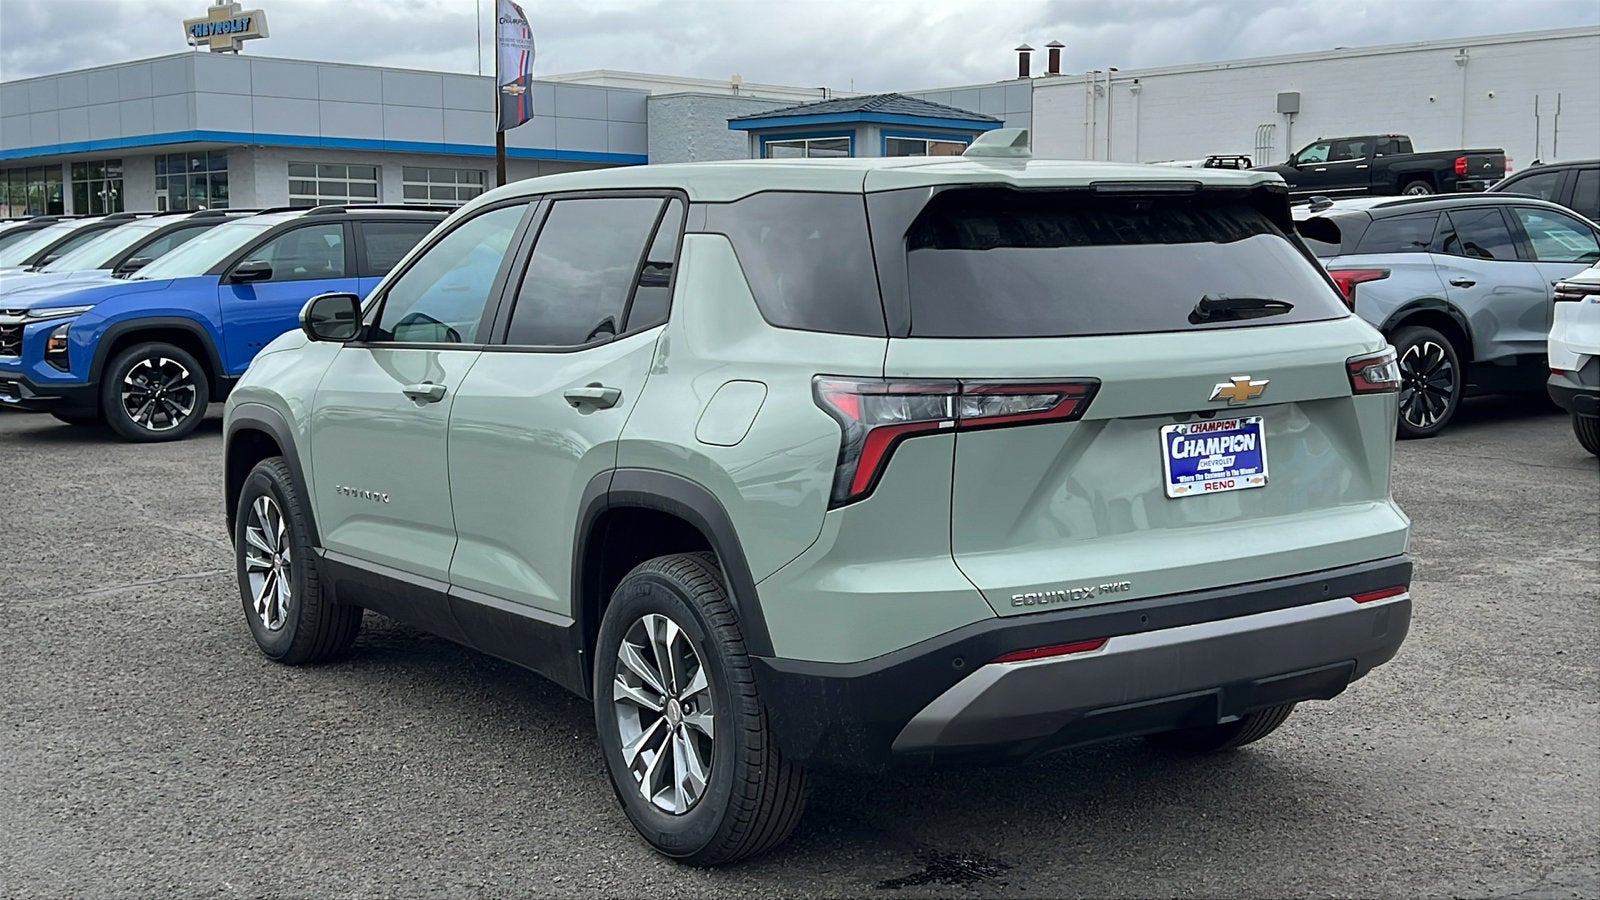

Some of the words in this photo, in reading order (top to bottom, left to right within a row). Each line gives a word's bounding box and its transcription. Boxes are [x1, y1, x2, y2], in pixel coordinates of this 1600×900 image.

[188, 17, 251, 37] CHEVROLET
[1190, 420, 1237, 433] CHAMPION
[1171, 433, 1256, 459] CHAMPION
[1200, 457, 1233, 468] CHEVROLET
[335, 485, 389, 504] EQUINOX
[1204, 480, 1235, 491] RENO
[1011, 586, 1095, 607] EQUINOX
[1099, 580, 1131, 595] AWD
